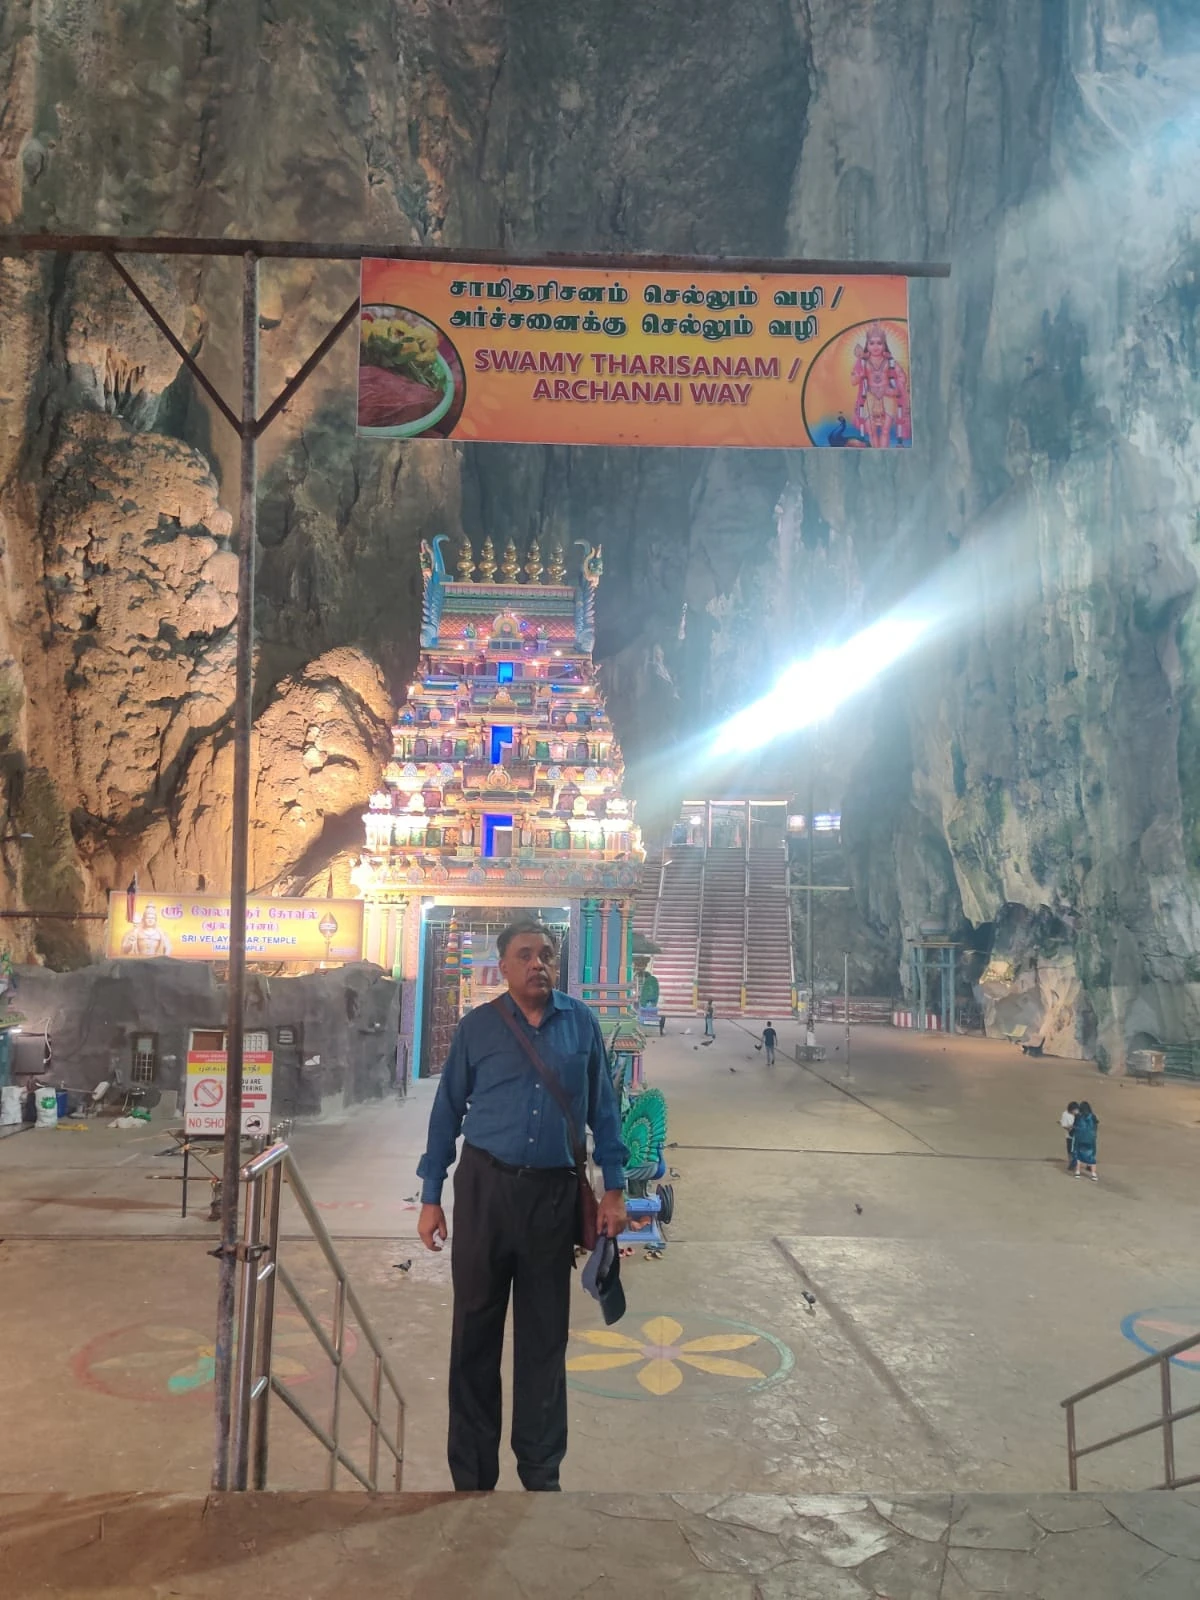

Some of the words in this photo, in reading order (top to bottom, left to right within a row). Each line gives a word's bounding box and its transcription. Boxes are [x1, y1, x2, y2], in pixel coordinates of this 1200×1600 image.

[449, 278, 628, 303] சாமிதரிசனம்
[643, 284, 758, 309] செல்லும்
[774, 286, 824, 310] வழி
[830, 286, 843, 308] /
[449, 306, 627, 335] அர்ச்சனைக்கு
[642, 313, 754, 339] செல்லும்
[768, 315, 818, 341] வழி
[474, 349, 583, 372] SWAMY
[590, 353, 779, 377] THARISANAM
[787, 357, 801, 381] /
[532, 378, 681, 403] ARCHANAI
[689, 383, 752, 404] WAY
[181, 935, 197, 943] SRI
[262, 936, 297, 944] TEMPLE
[188, 1118, 202, 1128] NO
